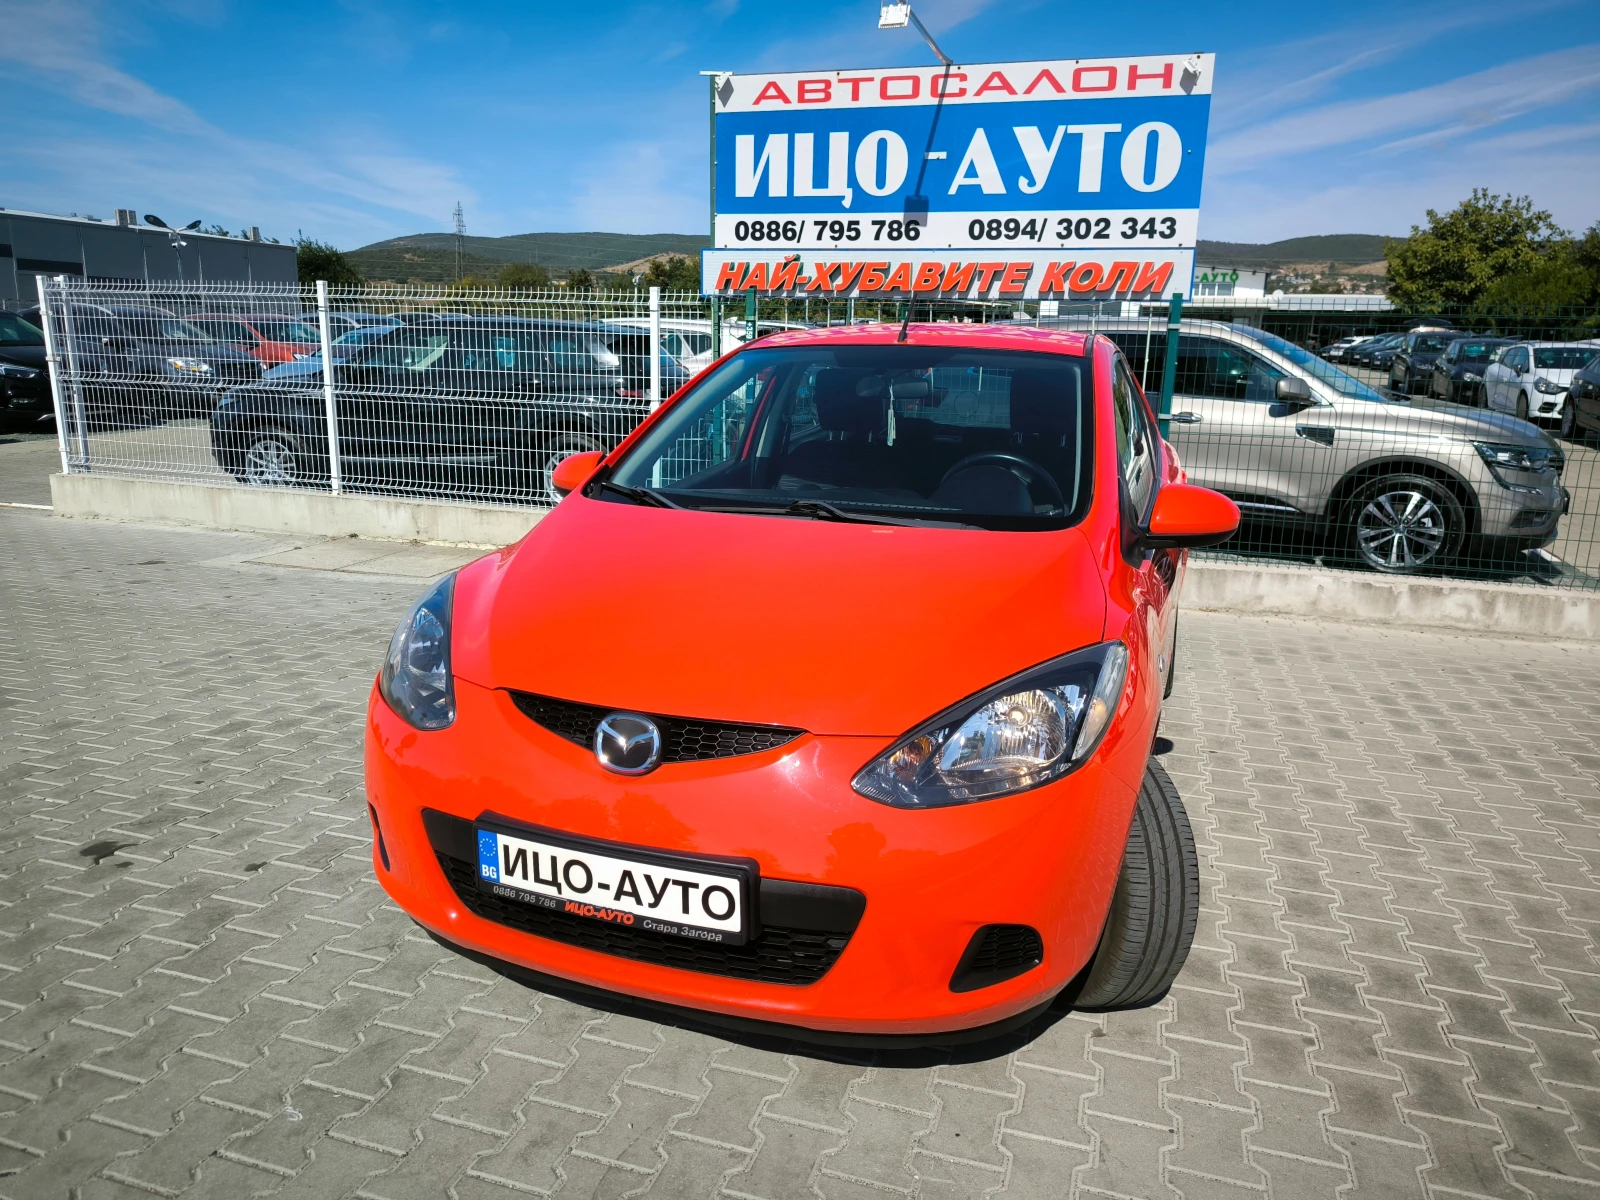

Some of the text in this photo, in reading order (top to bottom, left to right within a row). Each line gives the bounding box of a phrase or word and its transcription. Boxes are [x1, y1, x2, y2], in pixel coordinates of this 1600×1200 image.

[752, 62, 1174, 105] АВТОСАЛОН
[734, 216, 1177, 243] 0886/ 795 786 0894/ 302 343
[715, 253, 1174, 293] НАЙ-ХУБАВИТЕ КОЛИ
[481, 864, 498, 880] BG
[502, 844, 736, 921] ИЦО-АУТО
[492, 885, 723, 942] 0886 795 786 ИЦО-АУТО Стара Загора
